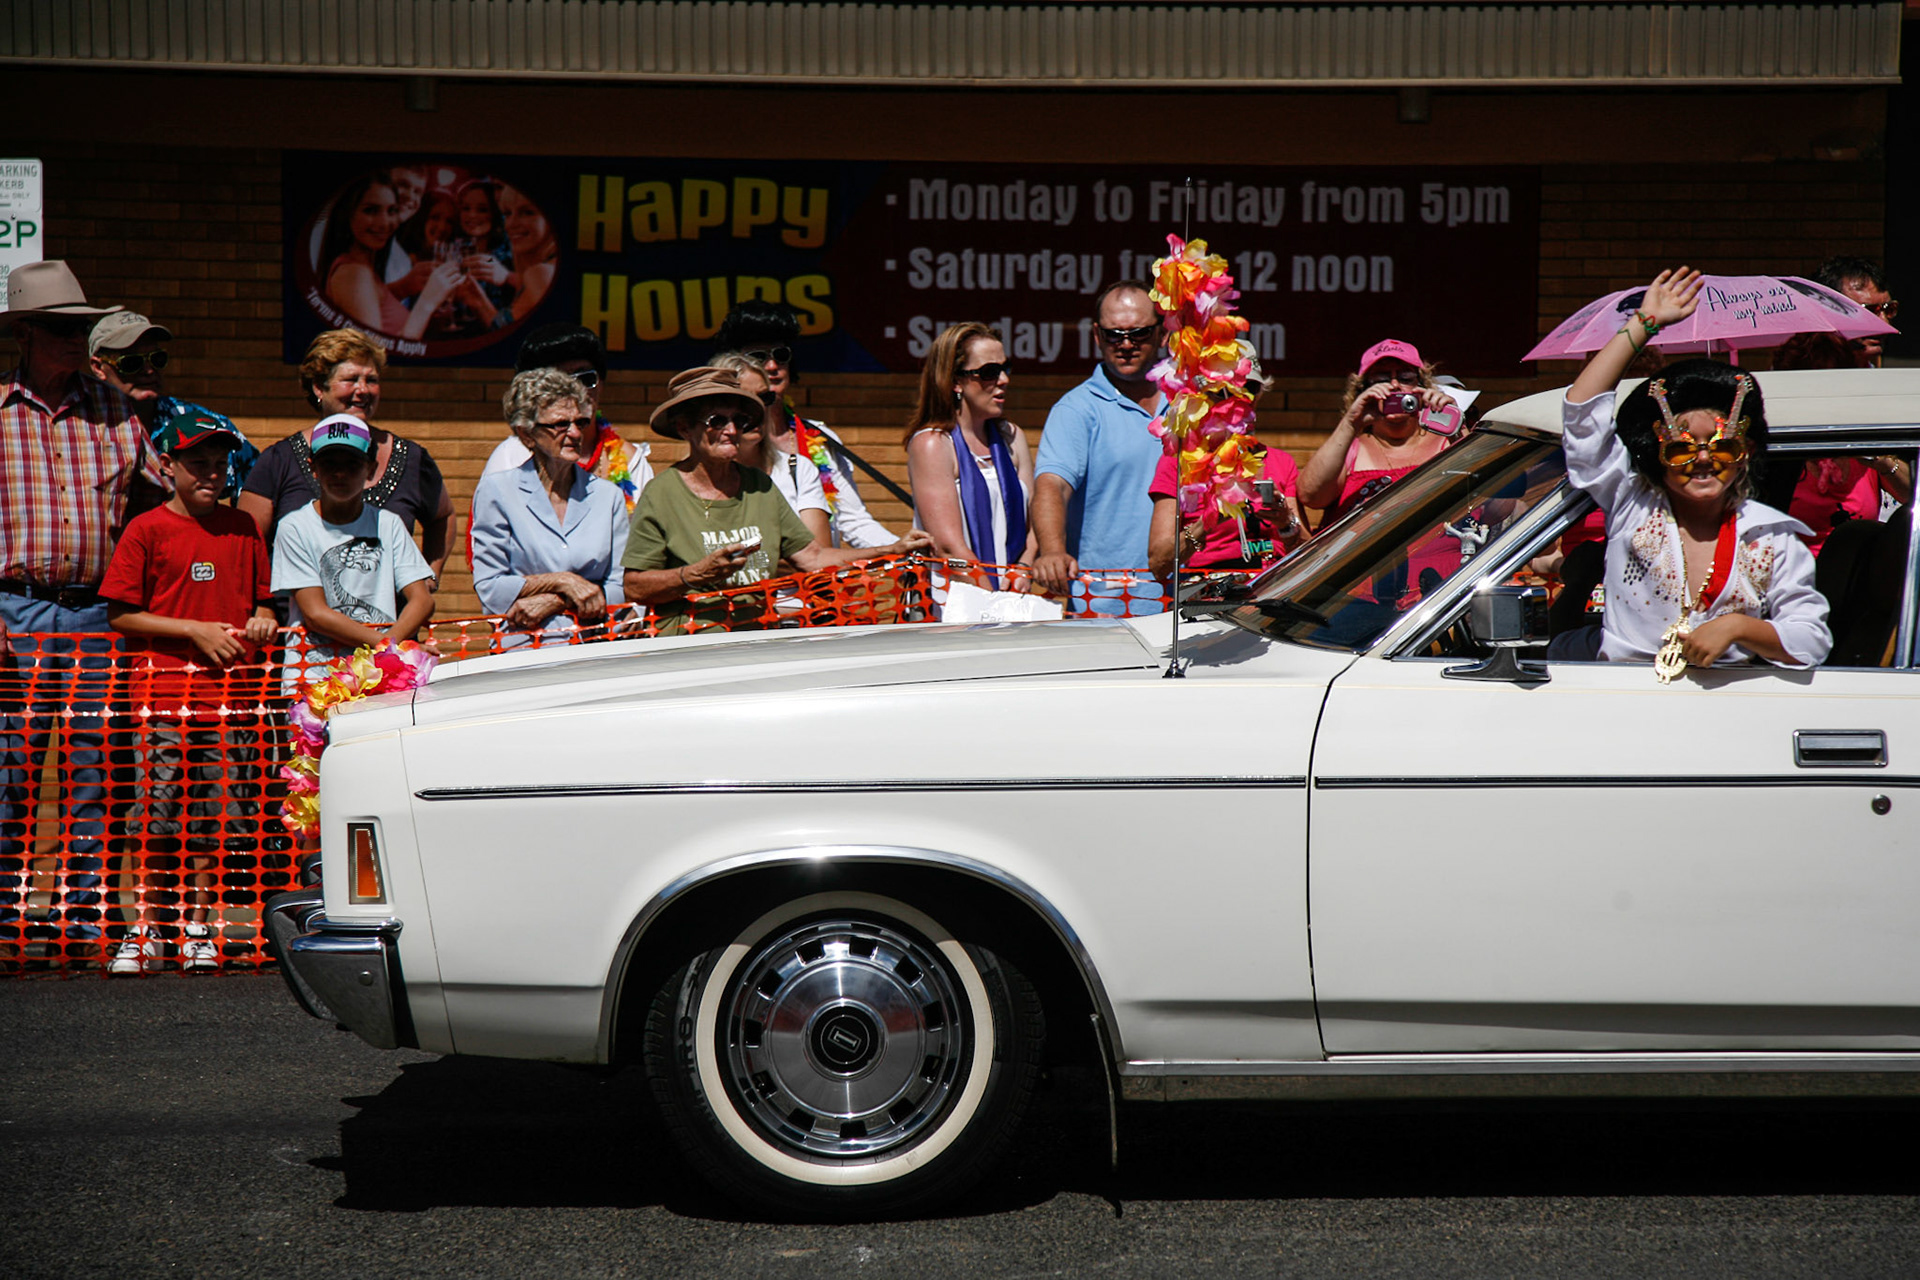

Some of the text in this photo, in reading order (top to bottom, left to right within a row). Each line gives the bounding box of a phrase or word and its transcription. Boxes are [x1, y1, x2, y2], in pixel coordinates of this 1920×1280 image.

[577, 174, 829, 253] Happy
[908, 178, 1510, 227] Monday to Friday from 5pm
[907, 246, 1103, 295] Saturday
[1234, 250, 1278, 292] 12
[1292, 255, 1395, 292] noon
[1705, 286, 1787, 312] Always on
[1733, 294, 1797, 329] my mind
[396, 339, 427, 357] Apply
[701, 525, 762, 545] MAJOR
